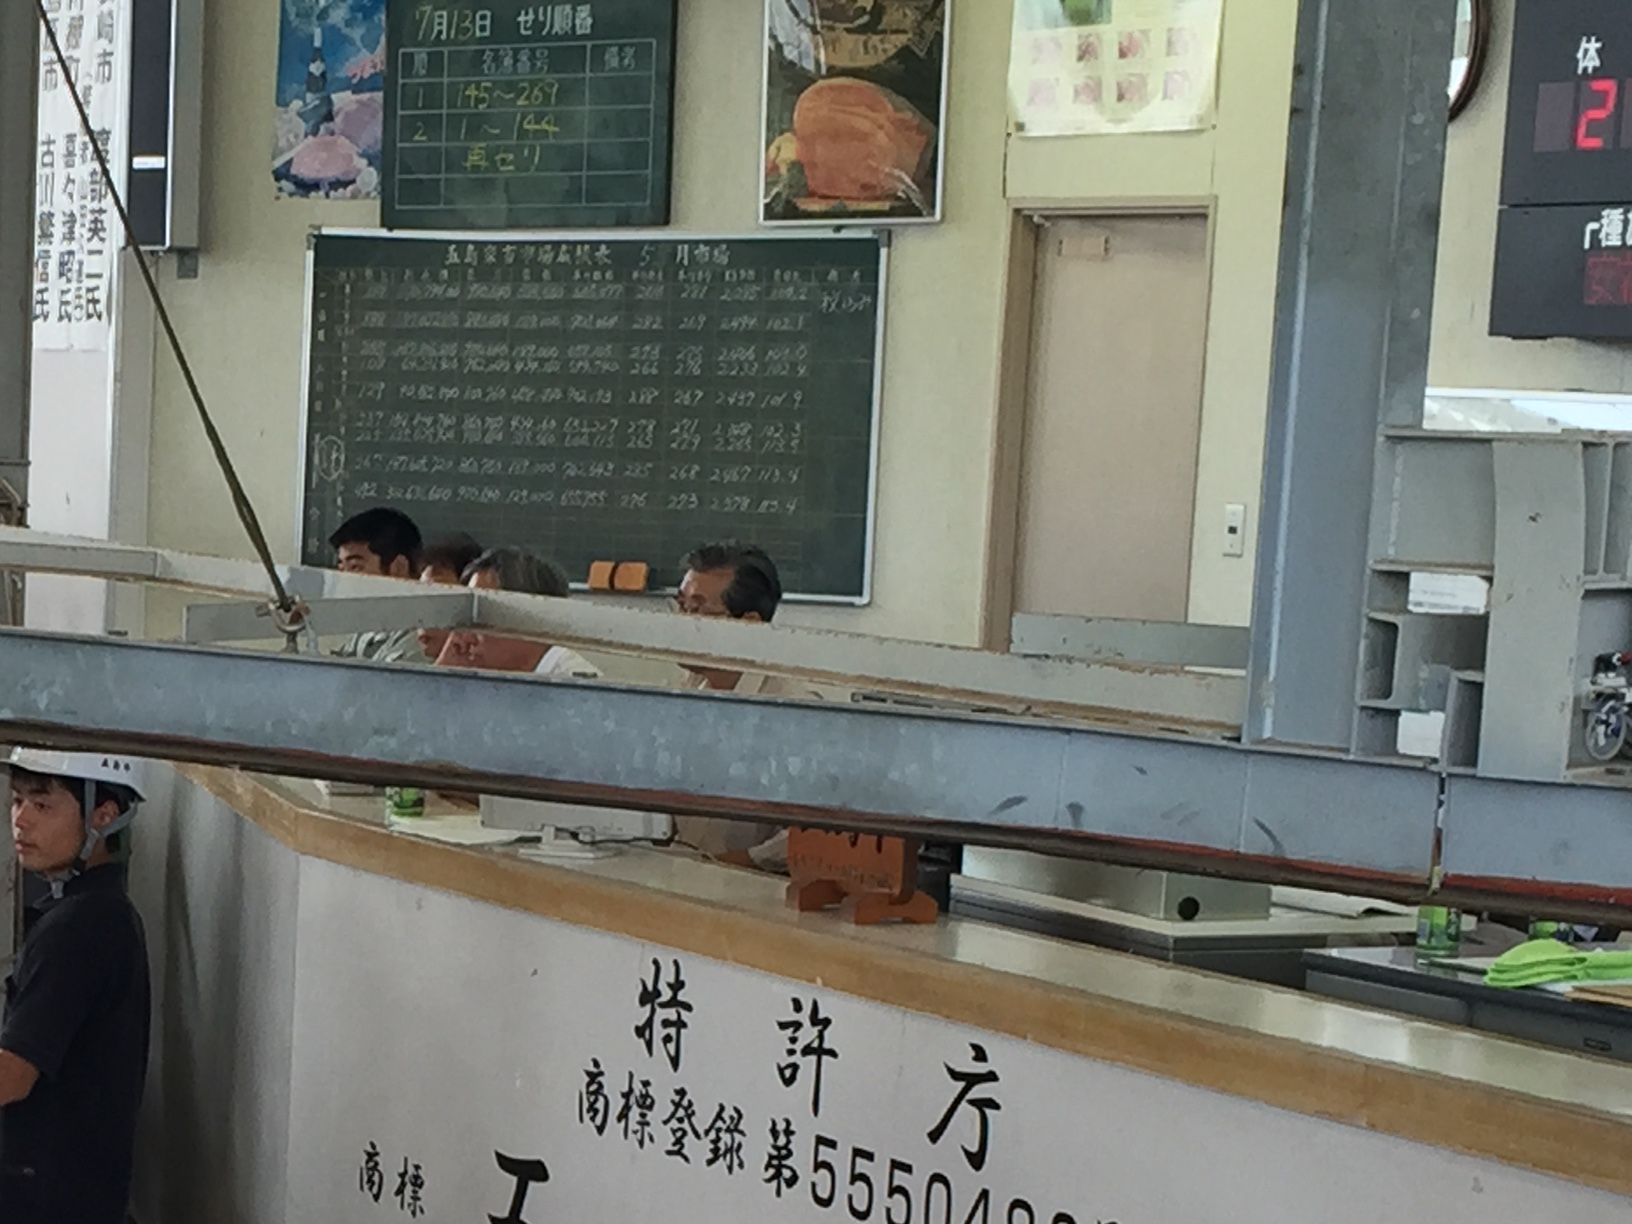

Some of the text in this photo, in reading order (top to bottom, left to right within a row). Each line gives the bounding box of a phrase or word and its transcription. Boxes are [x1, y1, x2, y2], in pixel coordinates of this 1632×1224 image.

[415, 4, 492, 41] 7月13日
[413, 121, 427, 141] 2
[1575, 79, 1618, 149] 2
[357, 1141, 427, 1220] 商標
